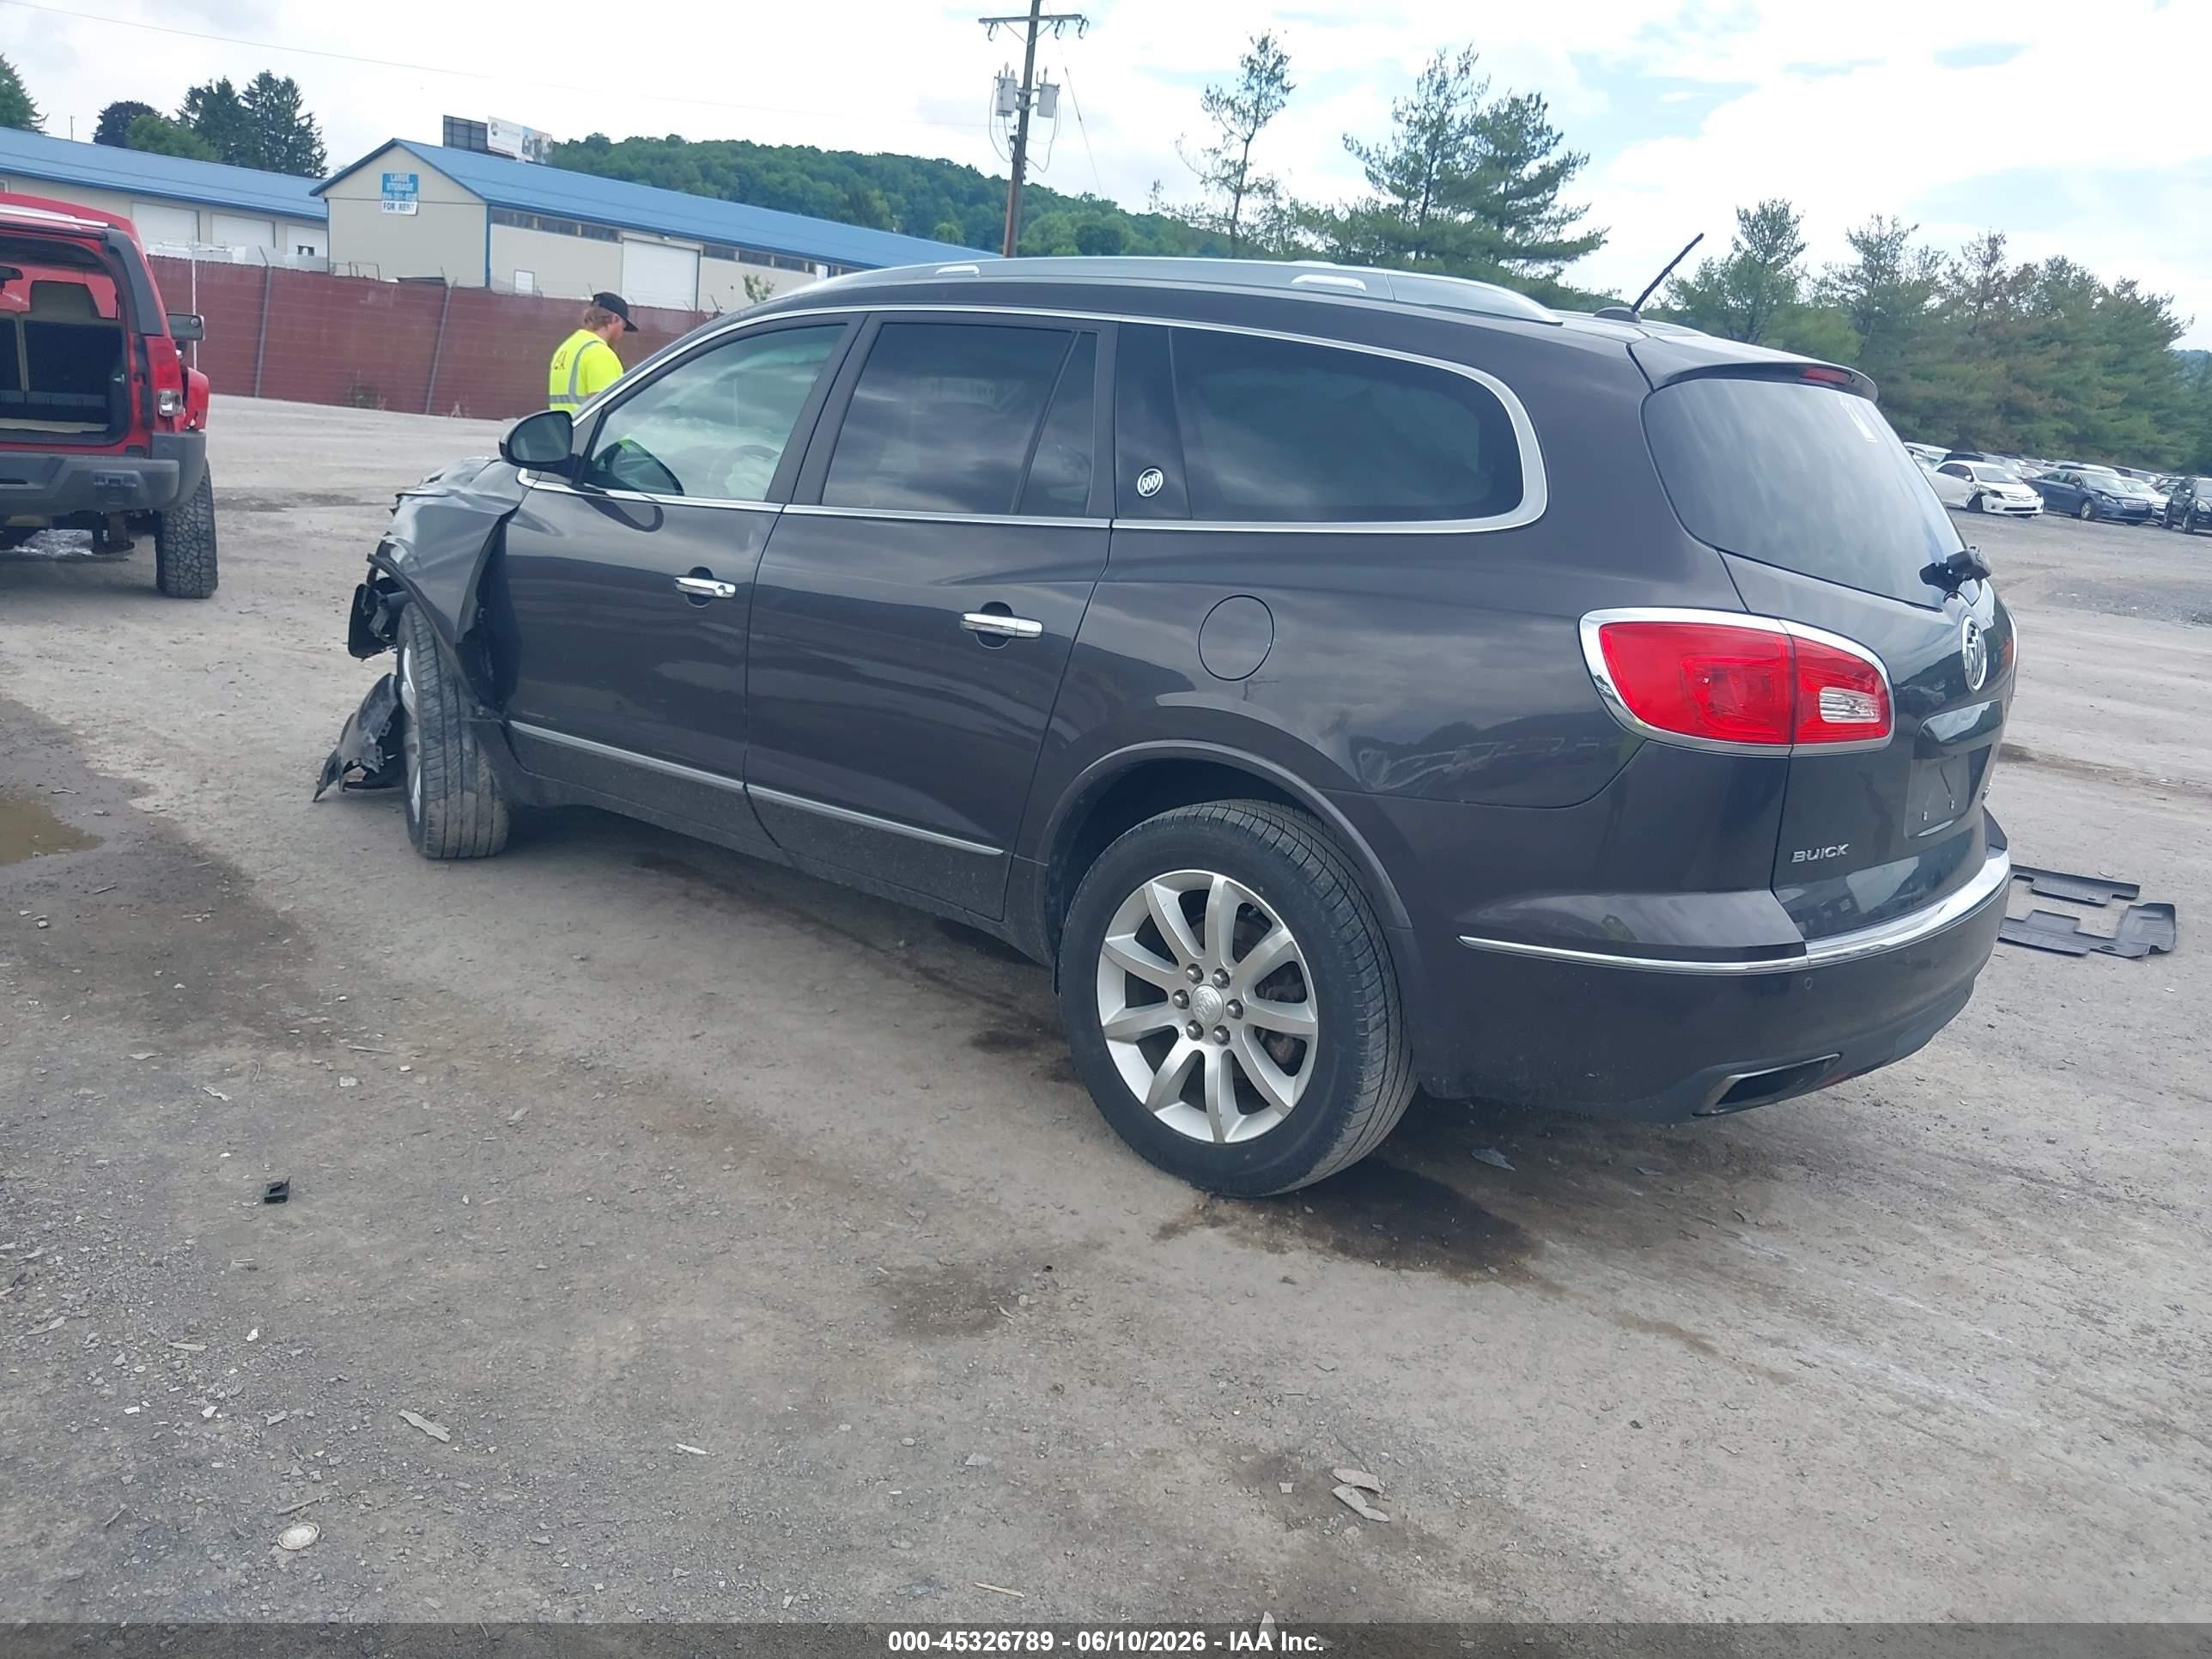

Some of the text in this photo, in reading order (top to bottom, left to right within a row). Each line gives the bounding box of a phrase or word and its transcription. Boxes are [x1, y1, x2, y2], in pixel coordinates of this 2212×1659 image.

[383, 202, 415, 212] FOR RENT
[1791, 843, 1850, 863] BUICK
